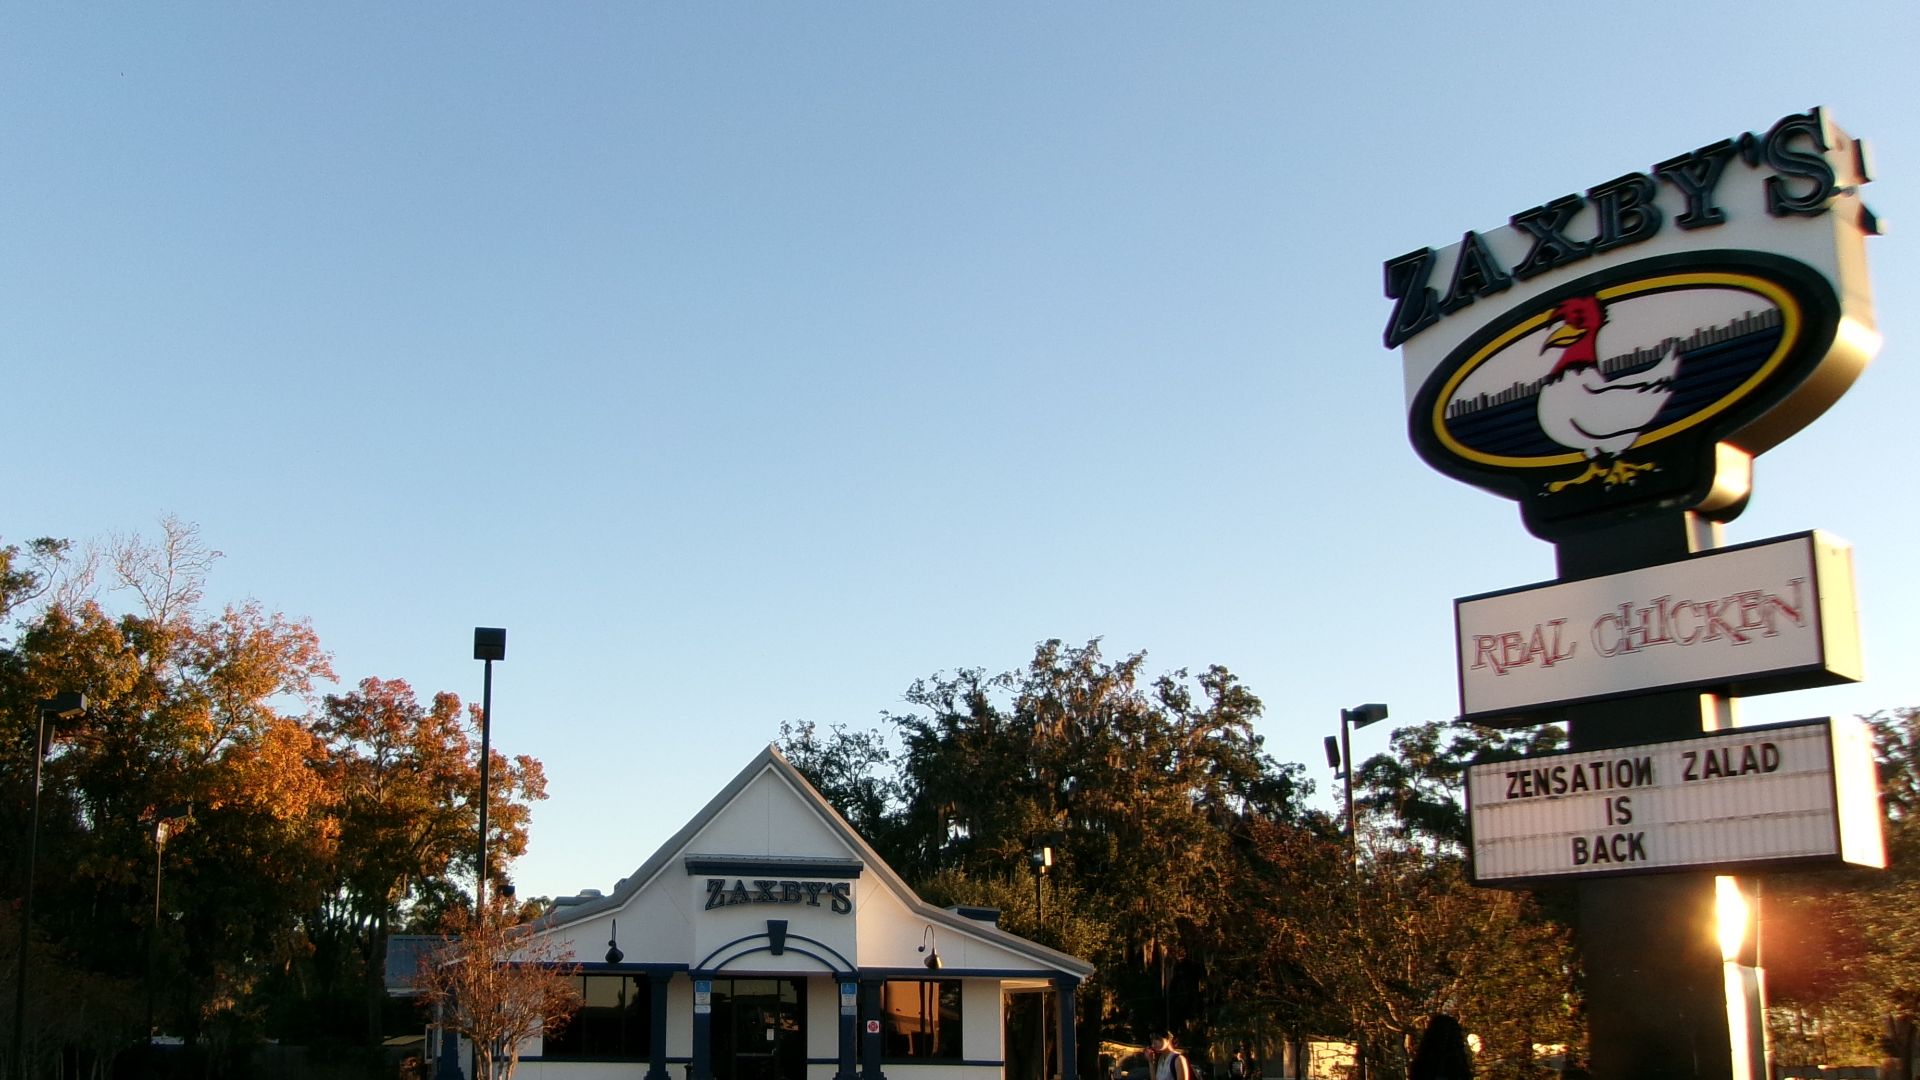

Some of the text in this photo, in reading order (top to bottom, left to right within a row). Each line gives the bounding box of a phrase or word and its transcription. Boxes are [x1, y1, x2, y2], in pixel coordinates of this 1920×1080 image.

[1384, 105, 1836, 349] ZAXBY'S
[1471, 576, 1806, 676] REAL CHICKEN
[1506, 742, 1781, 800] ZENSATION ZALAD
[1605, 796, 1632, 826] IS
[1572, 831, 1647, 866] BACK
[705, 878, 852, 915] ZAXBY'S
